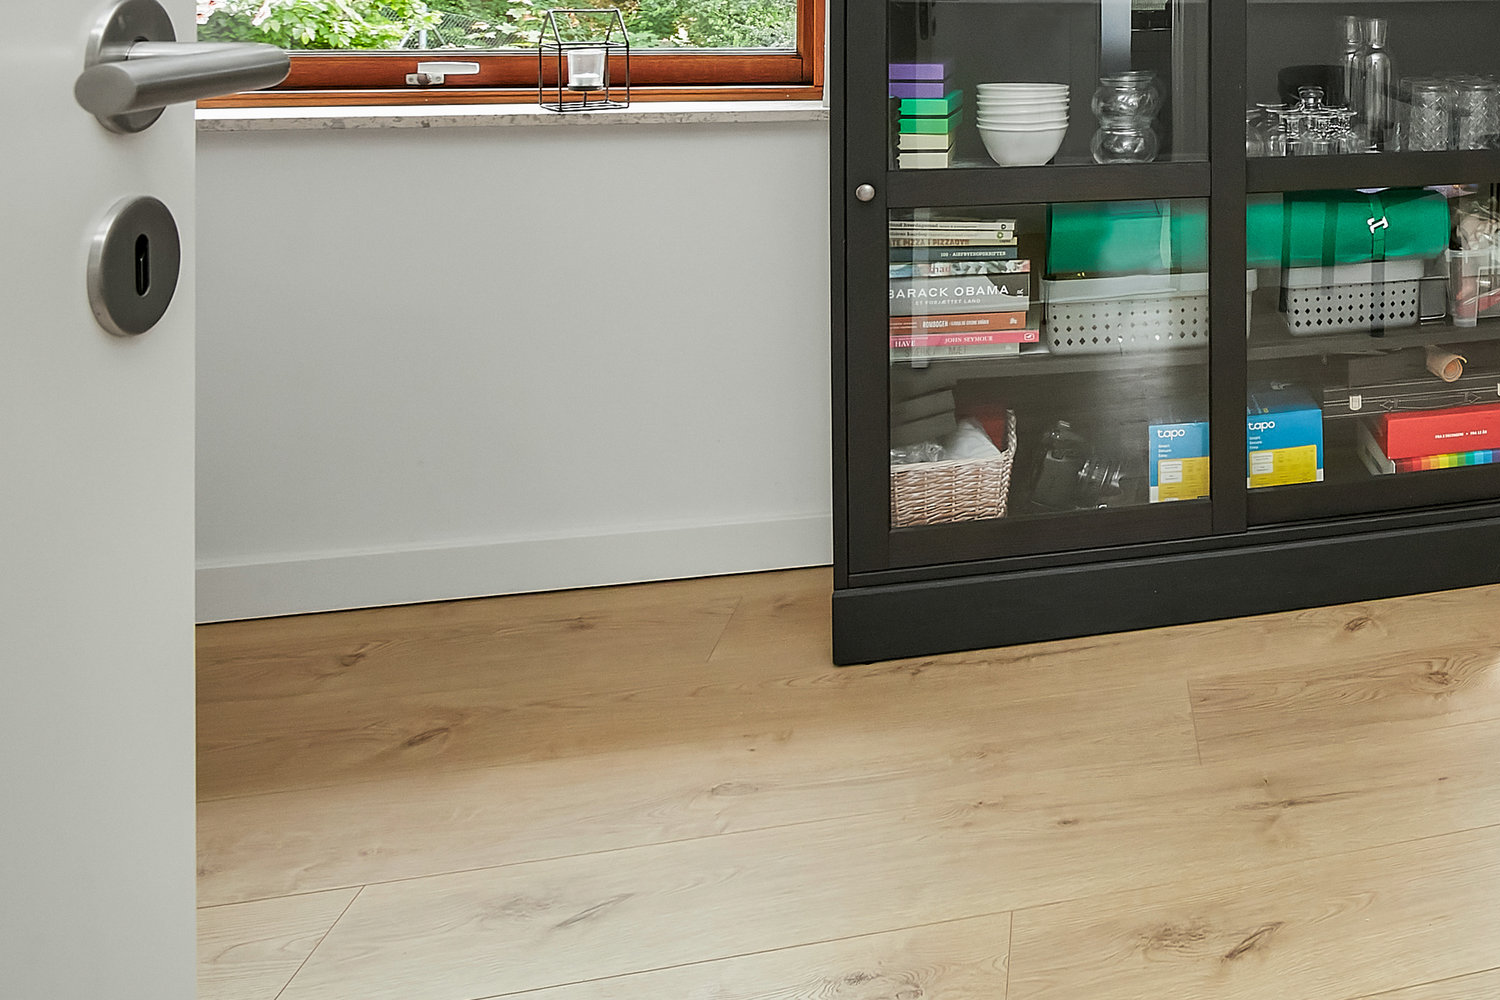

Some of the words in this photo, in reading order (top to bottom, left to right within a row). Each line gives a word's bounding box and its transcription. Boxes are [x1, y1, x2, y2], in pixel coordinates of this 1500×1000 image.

[889, 287, 948, 299] BARACK
[954, 285, 1009, 297] OBAMA
[895, 339, 916, 348] HAVE
[964, 335, 993, 343] SEYMOUR
[1248, 421, 1275, 432] tapo
[1157, 429, 1185, 440] tapo
